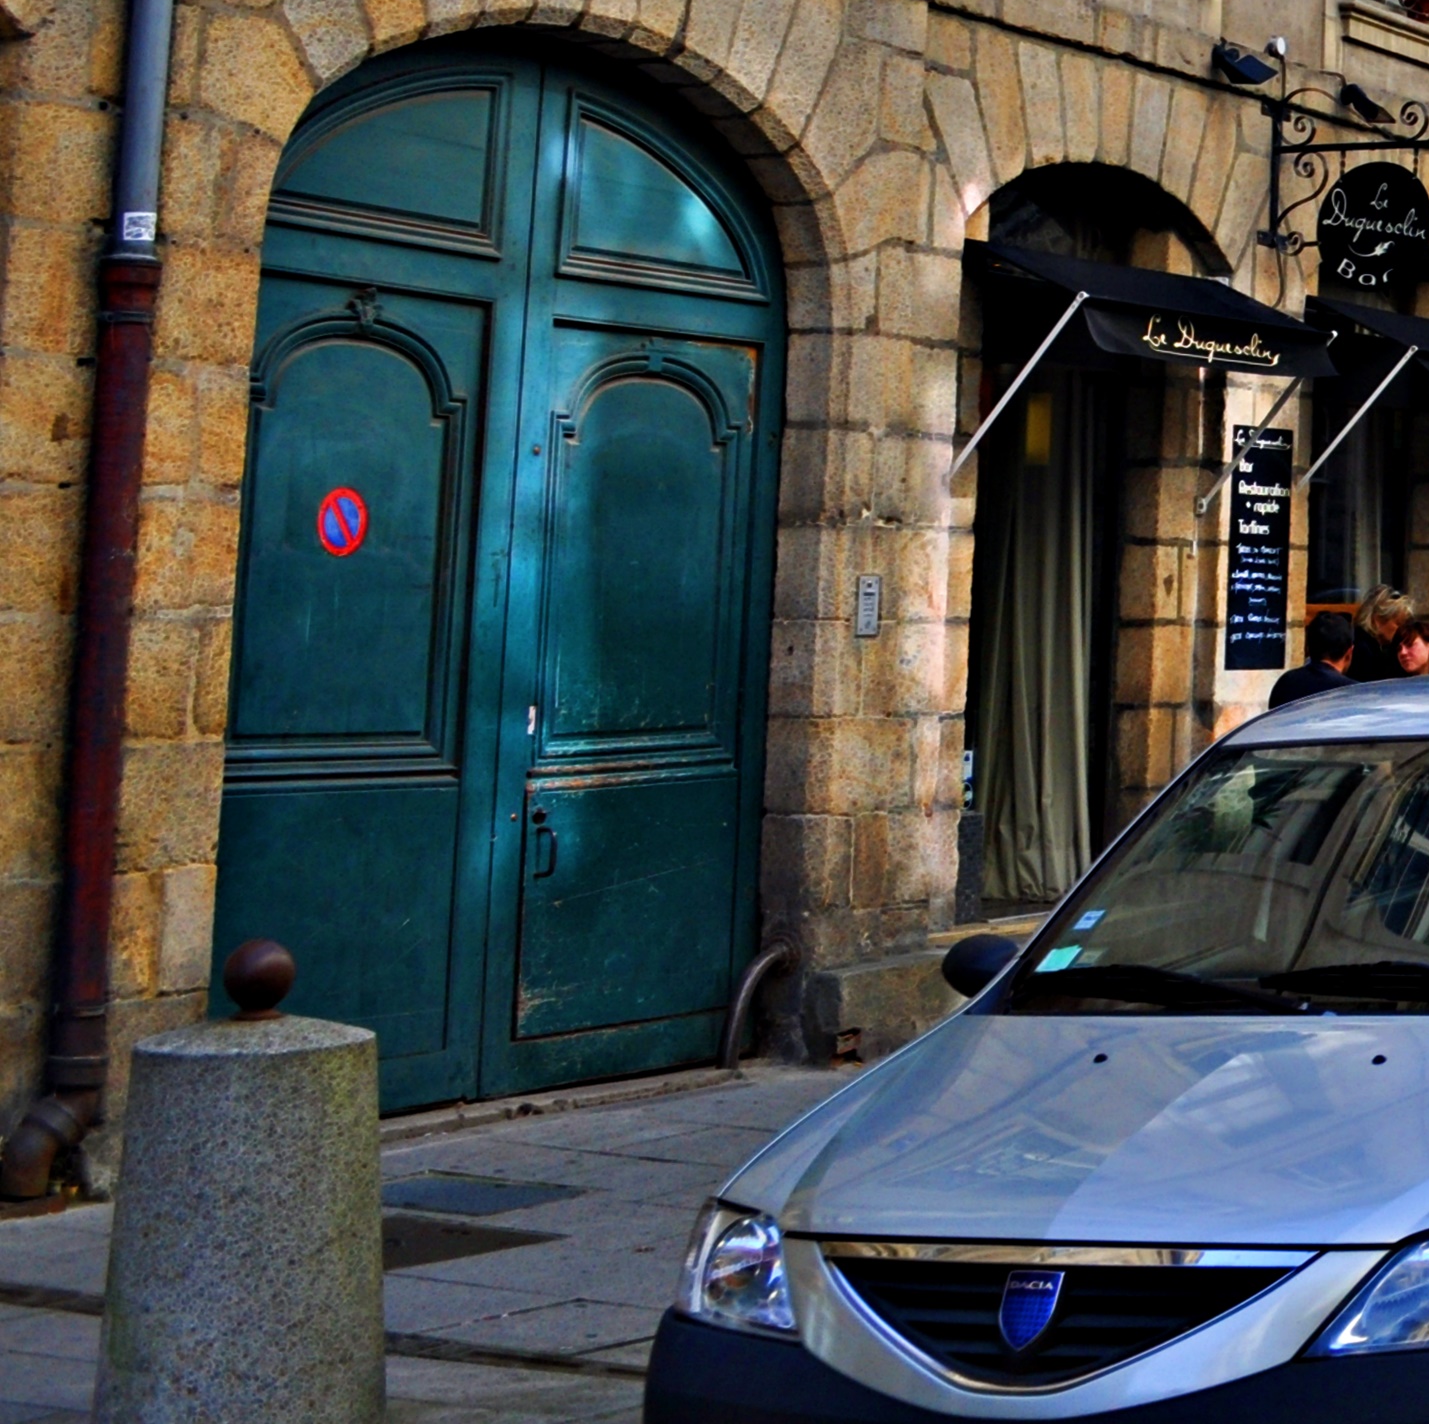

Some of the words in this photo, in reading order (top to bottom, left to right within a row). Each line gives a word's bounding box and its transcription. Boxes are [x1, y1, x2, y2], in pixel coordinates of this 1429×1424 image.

[1369, 182, 1388, 210] Le
[1336, 258, 1394, 286] Bar
[1142, 313, 1167, 347] Le
[1009, 1280, 1053, 1290] DACIA
